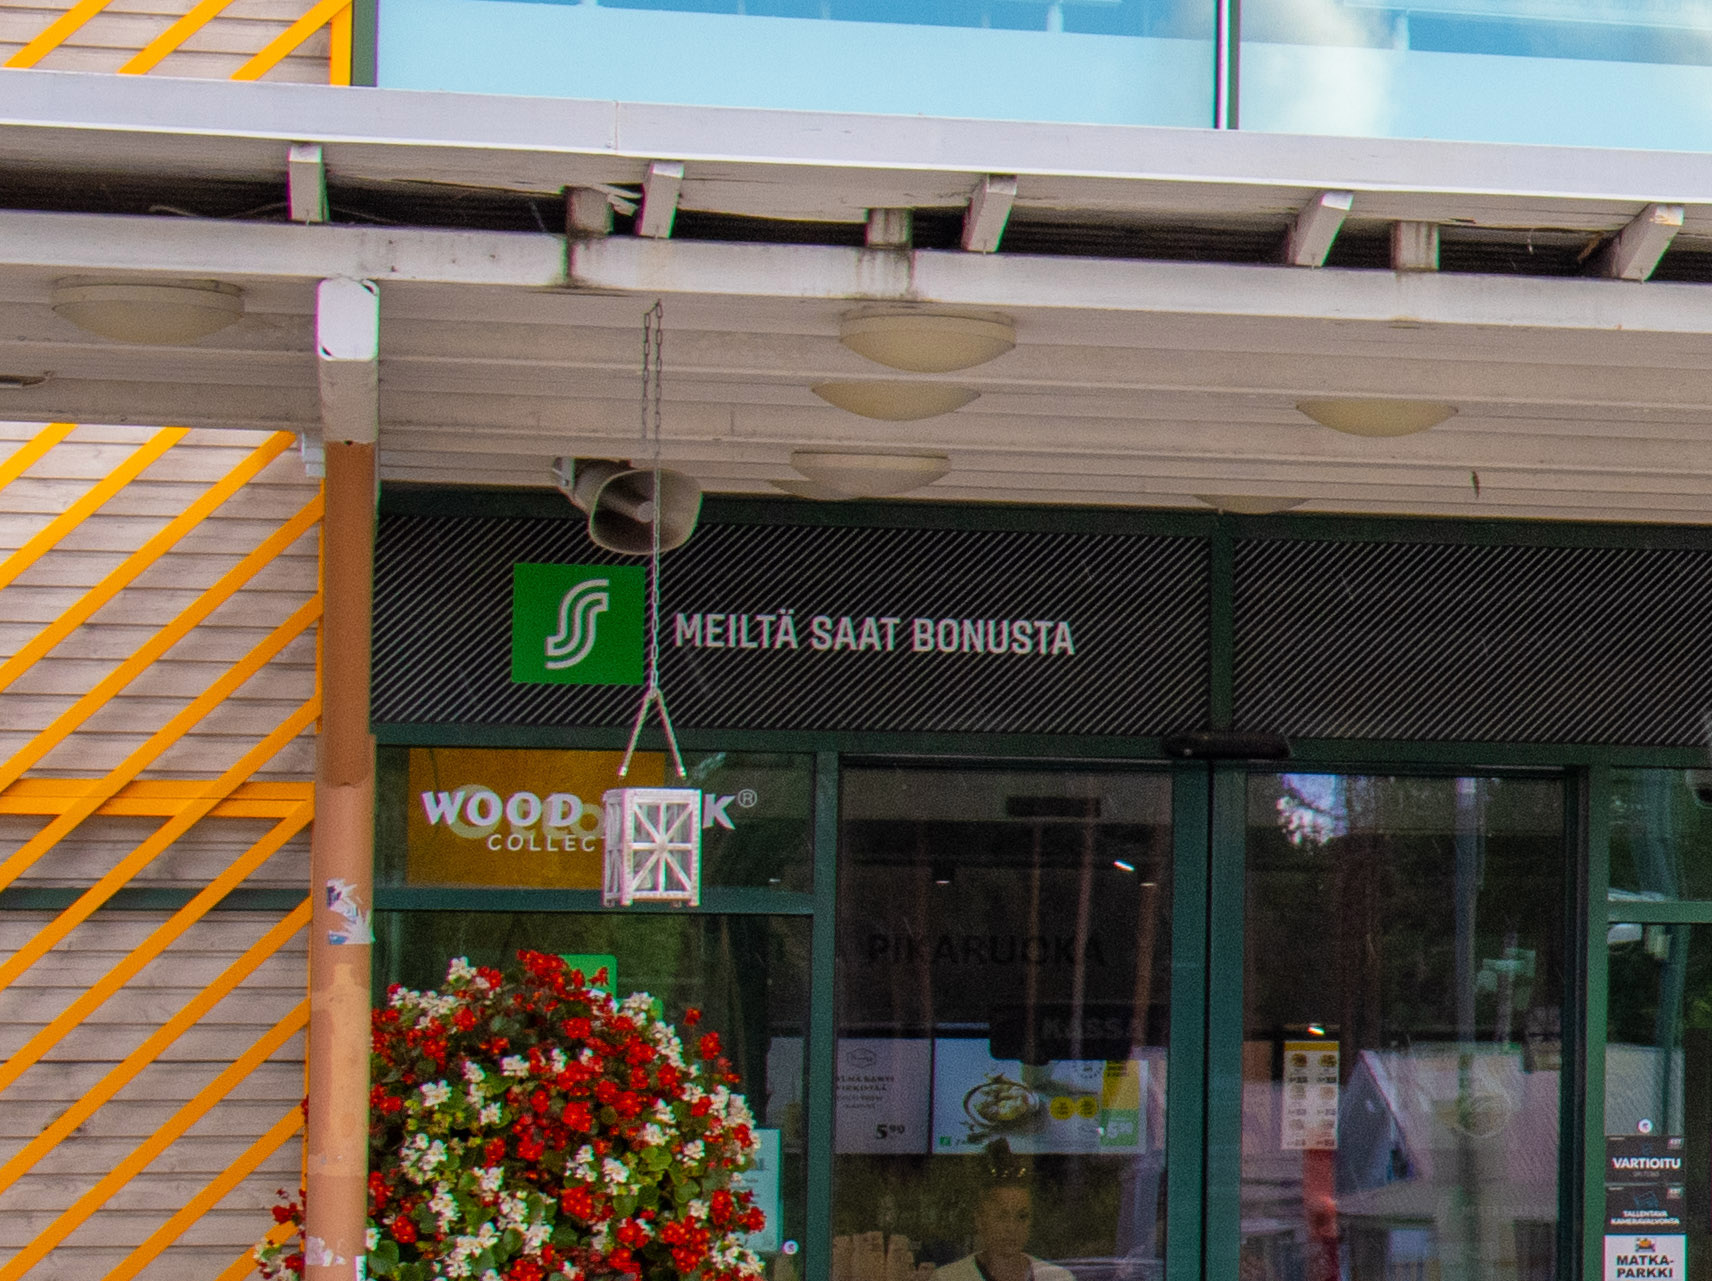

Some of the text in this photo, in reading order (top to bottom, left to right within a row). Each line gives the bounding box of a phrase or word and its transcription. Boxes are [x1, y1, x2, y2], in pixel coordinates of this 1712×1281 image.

[674, 608, 1075, 656] MEILTÄ SAAT BONUSTA
[1612, 1157, 1681, 1170] VARTIOITU
[1616, 1255, 1674, 1266] MATKA-
[1616, 1267, 1673, 1279] PARKKI
